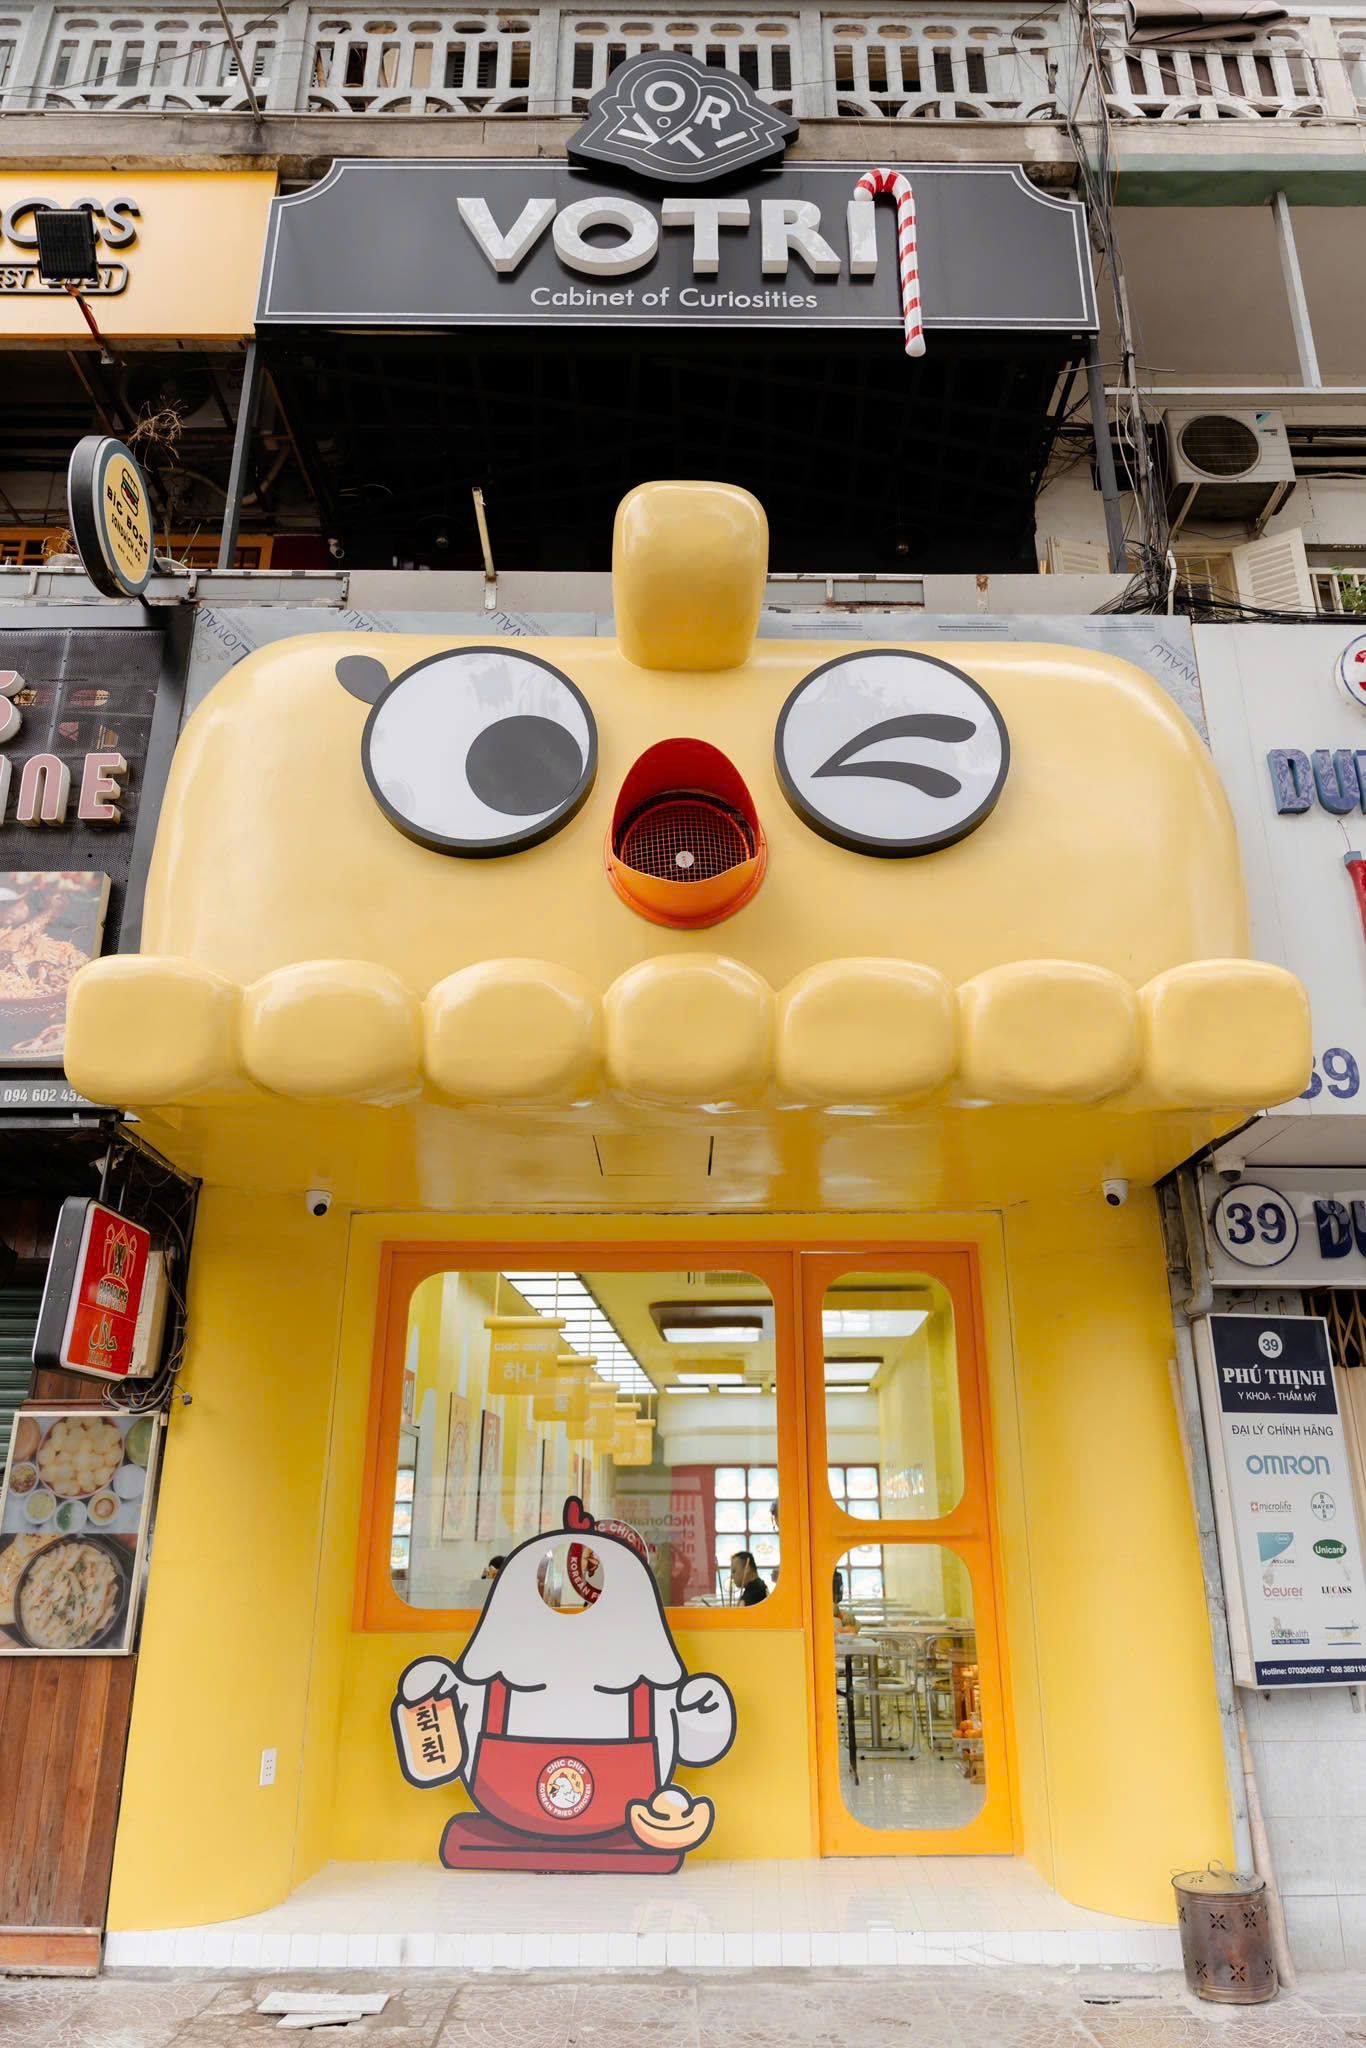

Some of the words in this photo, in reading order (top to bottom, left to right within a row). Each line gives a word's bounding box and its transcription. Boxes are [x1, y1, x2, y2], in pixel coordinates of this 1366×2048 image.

[457, 196, 878, 276] VOTRI
[530, 287, 634, 307] Cabinet
[642, 286, 670, 307] of
[679, 289, 818, 309] Curiosities
[126, 515, 148, 554] BOSS
[4, 1088, 28, 1103] 094
[32, 1088, 56, 1103] 602
[1226, 1203, 1287, 1245] 39
[1262, 1338, 1279, 1351] 39
[1222, 1364, 1261, 1385] PHÚ
[1264, 1368, 1327, 1390] THỊNH
[1238, 1391, 1244, 1400] Y
[1246, 1392, 1271, 1401] KHOA
[1253, 1422, 1264, 1435] LÝ
[1267, 1424, 1301, 1436] CHÍNH
[1303, 1424, 1334, 1436] HÃNG
[1259, 1501, 1292, 1510] microlife
[1263, 1586, 1303, 1597] beurer
[1321, 1586, 1352, 1594] LUCASS
[1262, 1668, 1287, 1676] Hotline:
[547, 1759, 566, 1774] CHIC
[567, 1760, 586, 1774] CHIC
